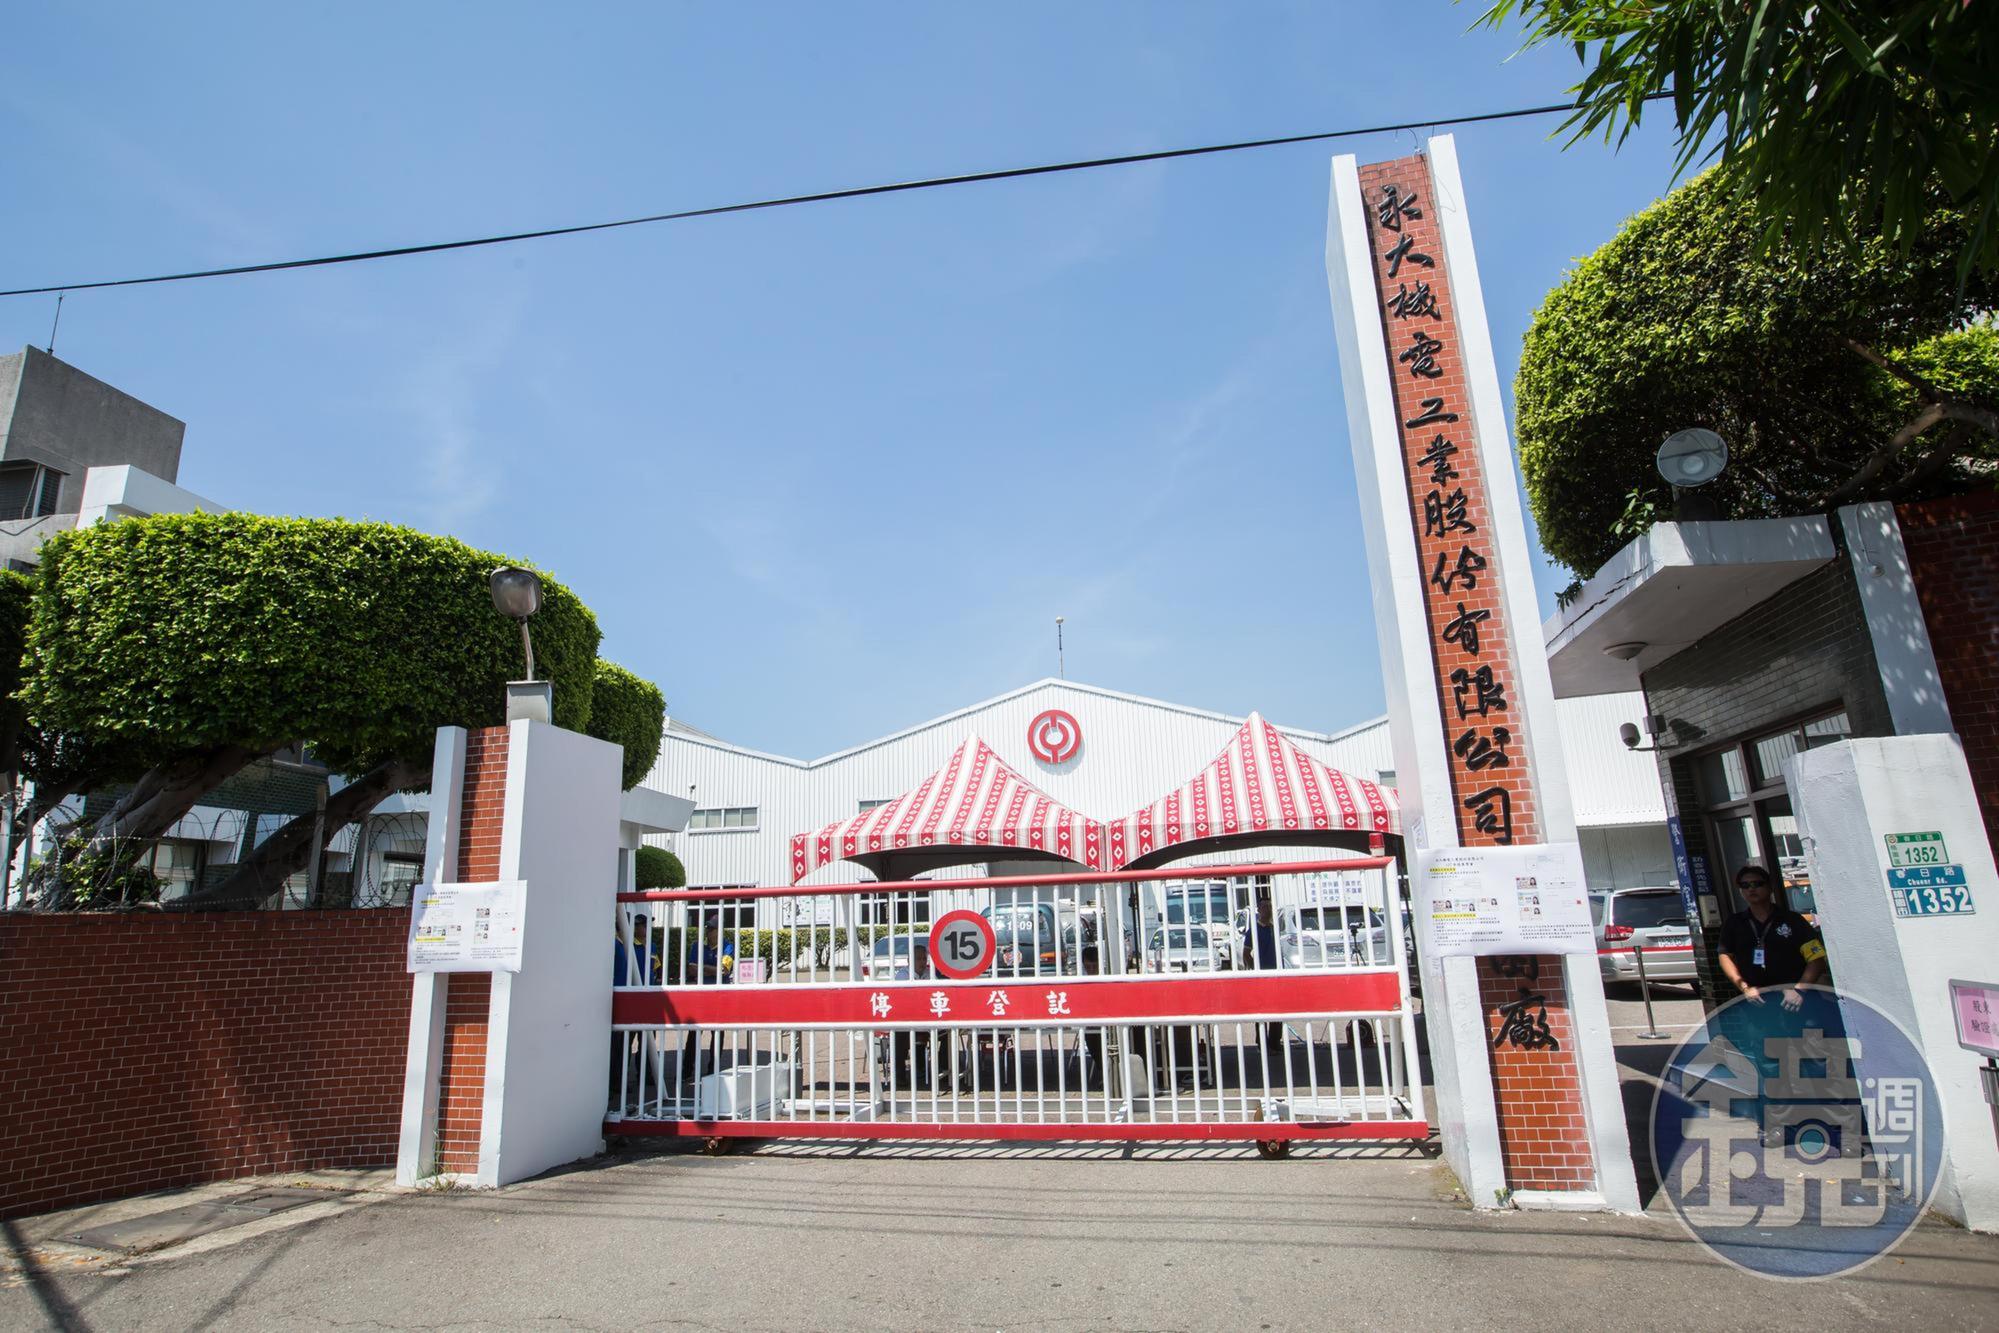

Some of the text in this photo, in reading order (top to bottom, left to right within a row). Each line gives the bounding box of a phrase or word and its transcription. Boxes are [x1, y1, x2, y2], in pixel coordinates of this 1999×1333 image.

[1377, 185, 1512, 845] 永大機電工業股份有限公司
[1905, 846, 1939, 863] 1352
[1908, 886, 1974, 914] 1352
[943, 930, 981, 961] 15
[870, 989, 1071, 1019] 停車登記
